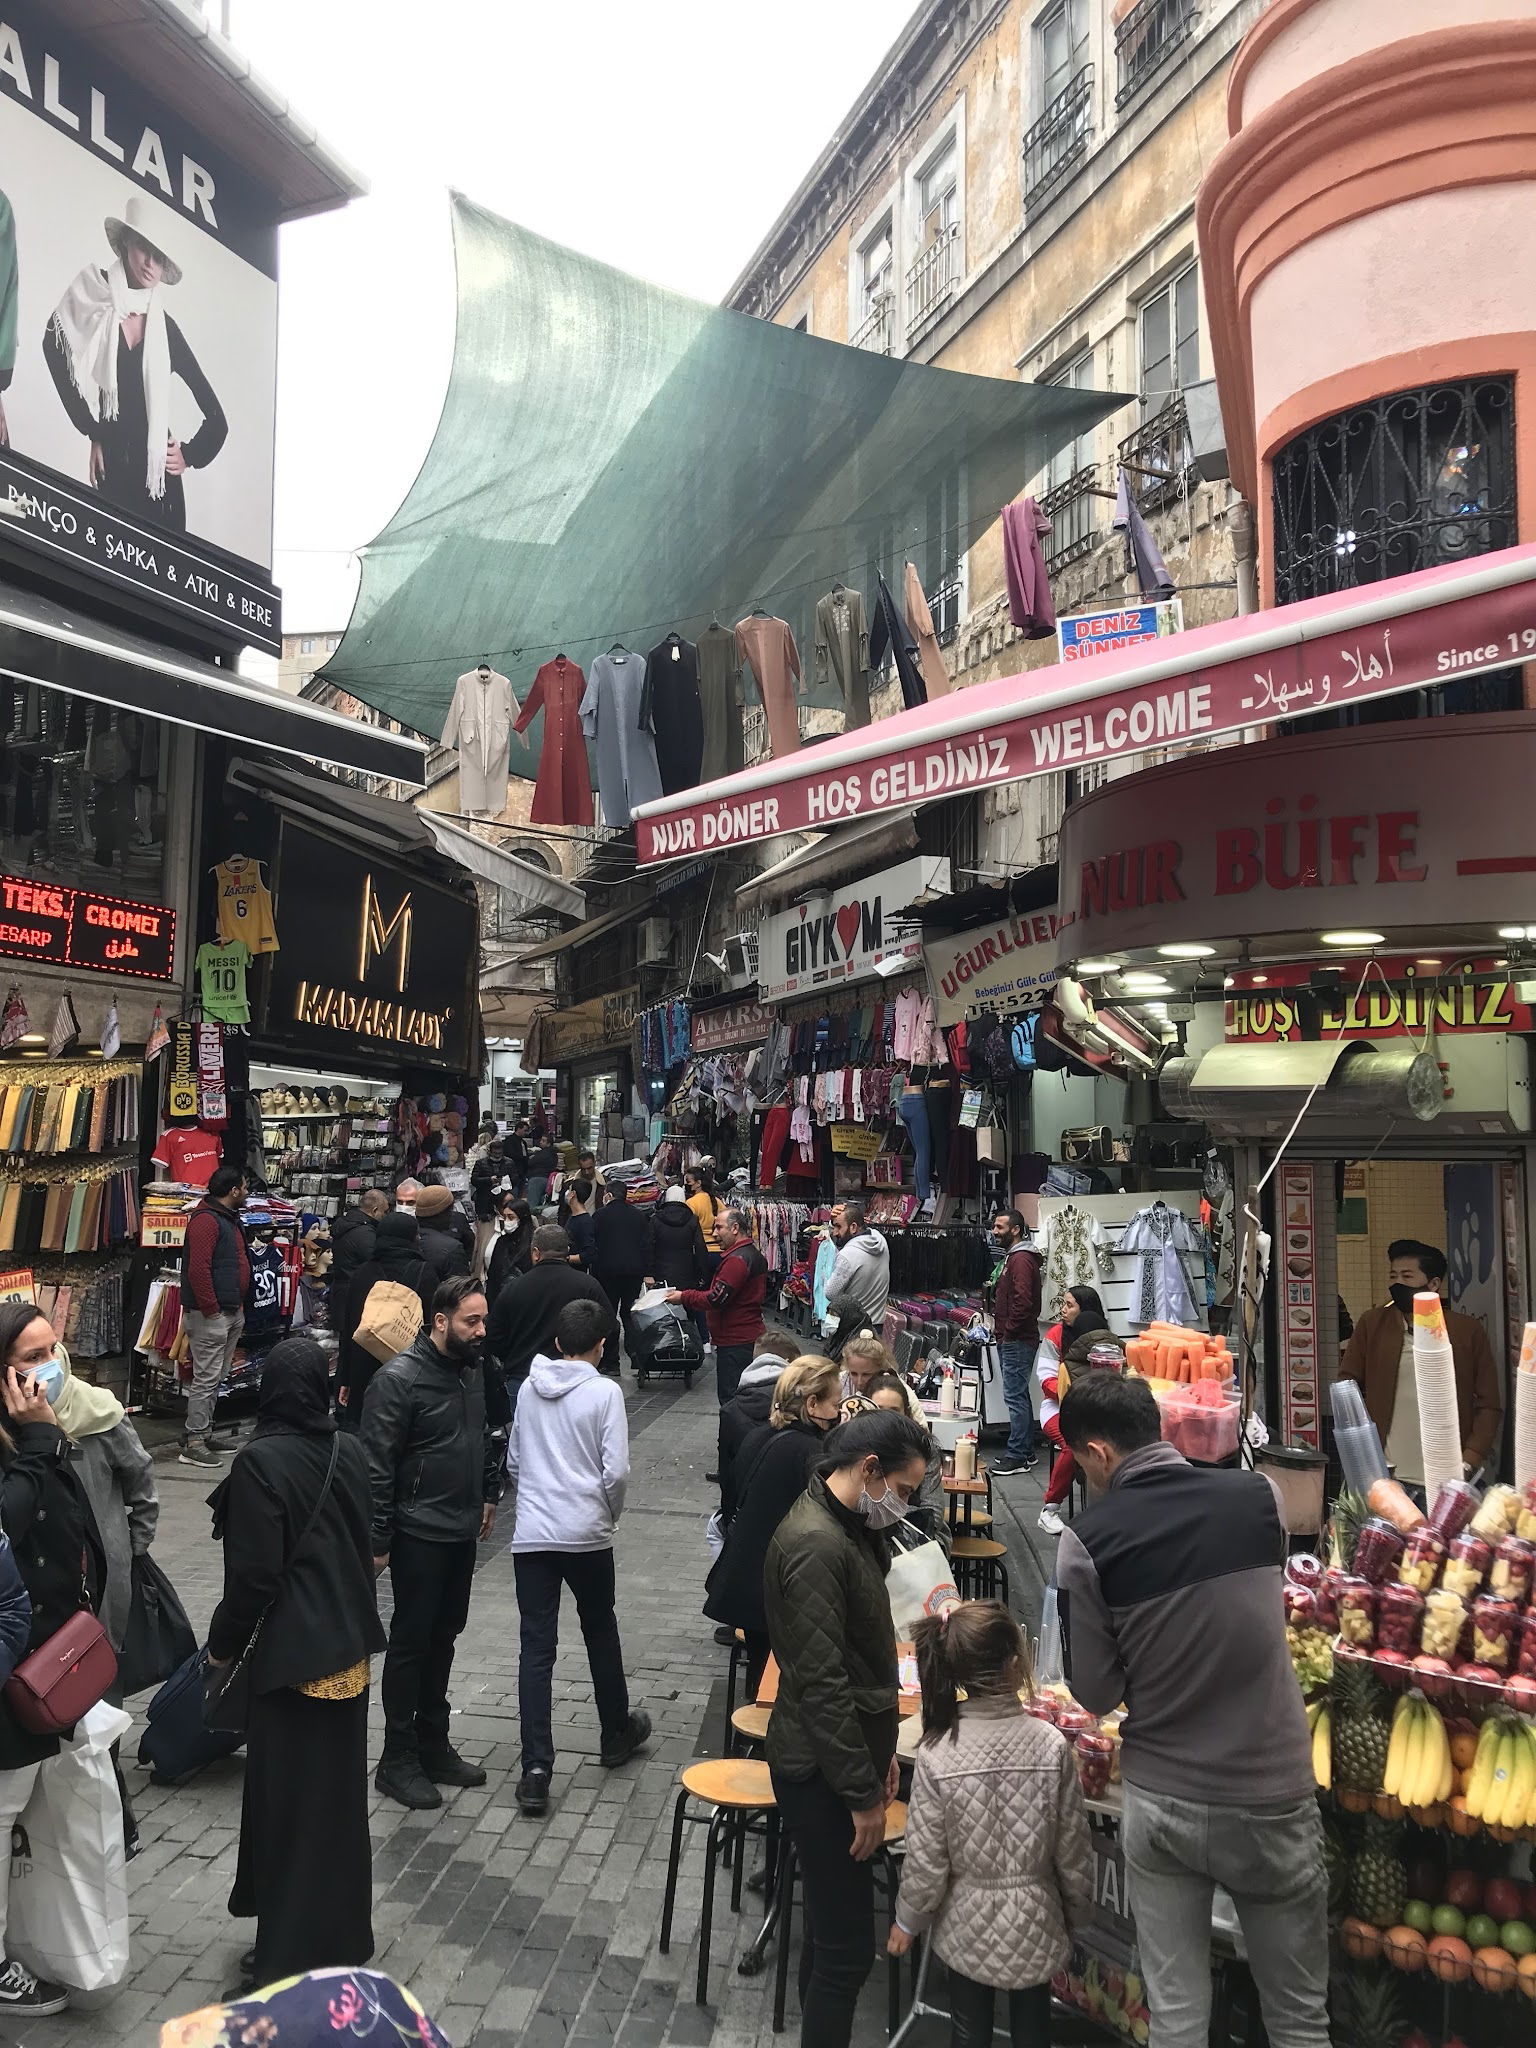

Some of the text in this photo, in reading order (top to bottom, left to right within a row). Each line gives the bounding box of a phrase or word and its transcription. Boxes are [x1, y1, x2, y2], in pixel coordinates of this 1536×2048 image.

[0, 22, 219, 229] ALLAR
[85, 526, 97, 545] &
[105, 534, 158, 575] ŞAPKA
[167, 565, 177, 582] &
[184, 573, 219, 602] ATKI
[226, 592, 236, 609] &
[241, 597, 272, 627] BERE
[1075, 611, 1141, 639] DENİZ
[1437, 643, 1500, 671] Since
[651, 684, 1214, 856] NUR DÖNER HOŞ GELDİNİZ WELCOME
[1079, 794, 1430, 920] NUR BÜFE
[236, 899, 248, 918] 6
[207, 956, 240, 968] MESSI
[210, 968, 236, 993] 10
[975, 970, 1057, 999] Bebeğinizi Güle Gül
[175, 1034, 191, 1087] BORUSSIA
[176, 1093, 192, 1106] BVB
[147, 1216, 188, 1229] SALLAR
[153, 1230, 172, 1244] 10
[254, 1269, 276, 1300] 30
